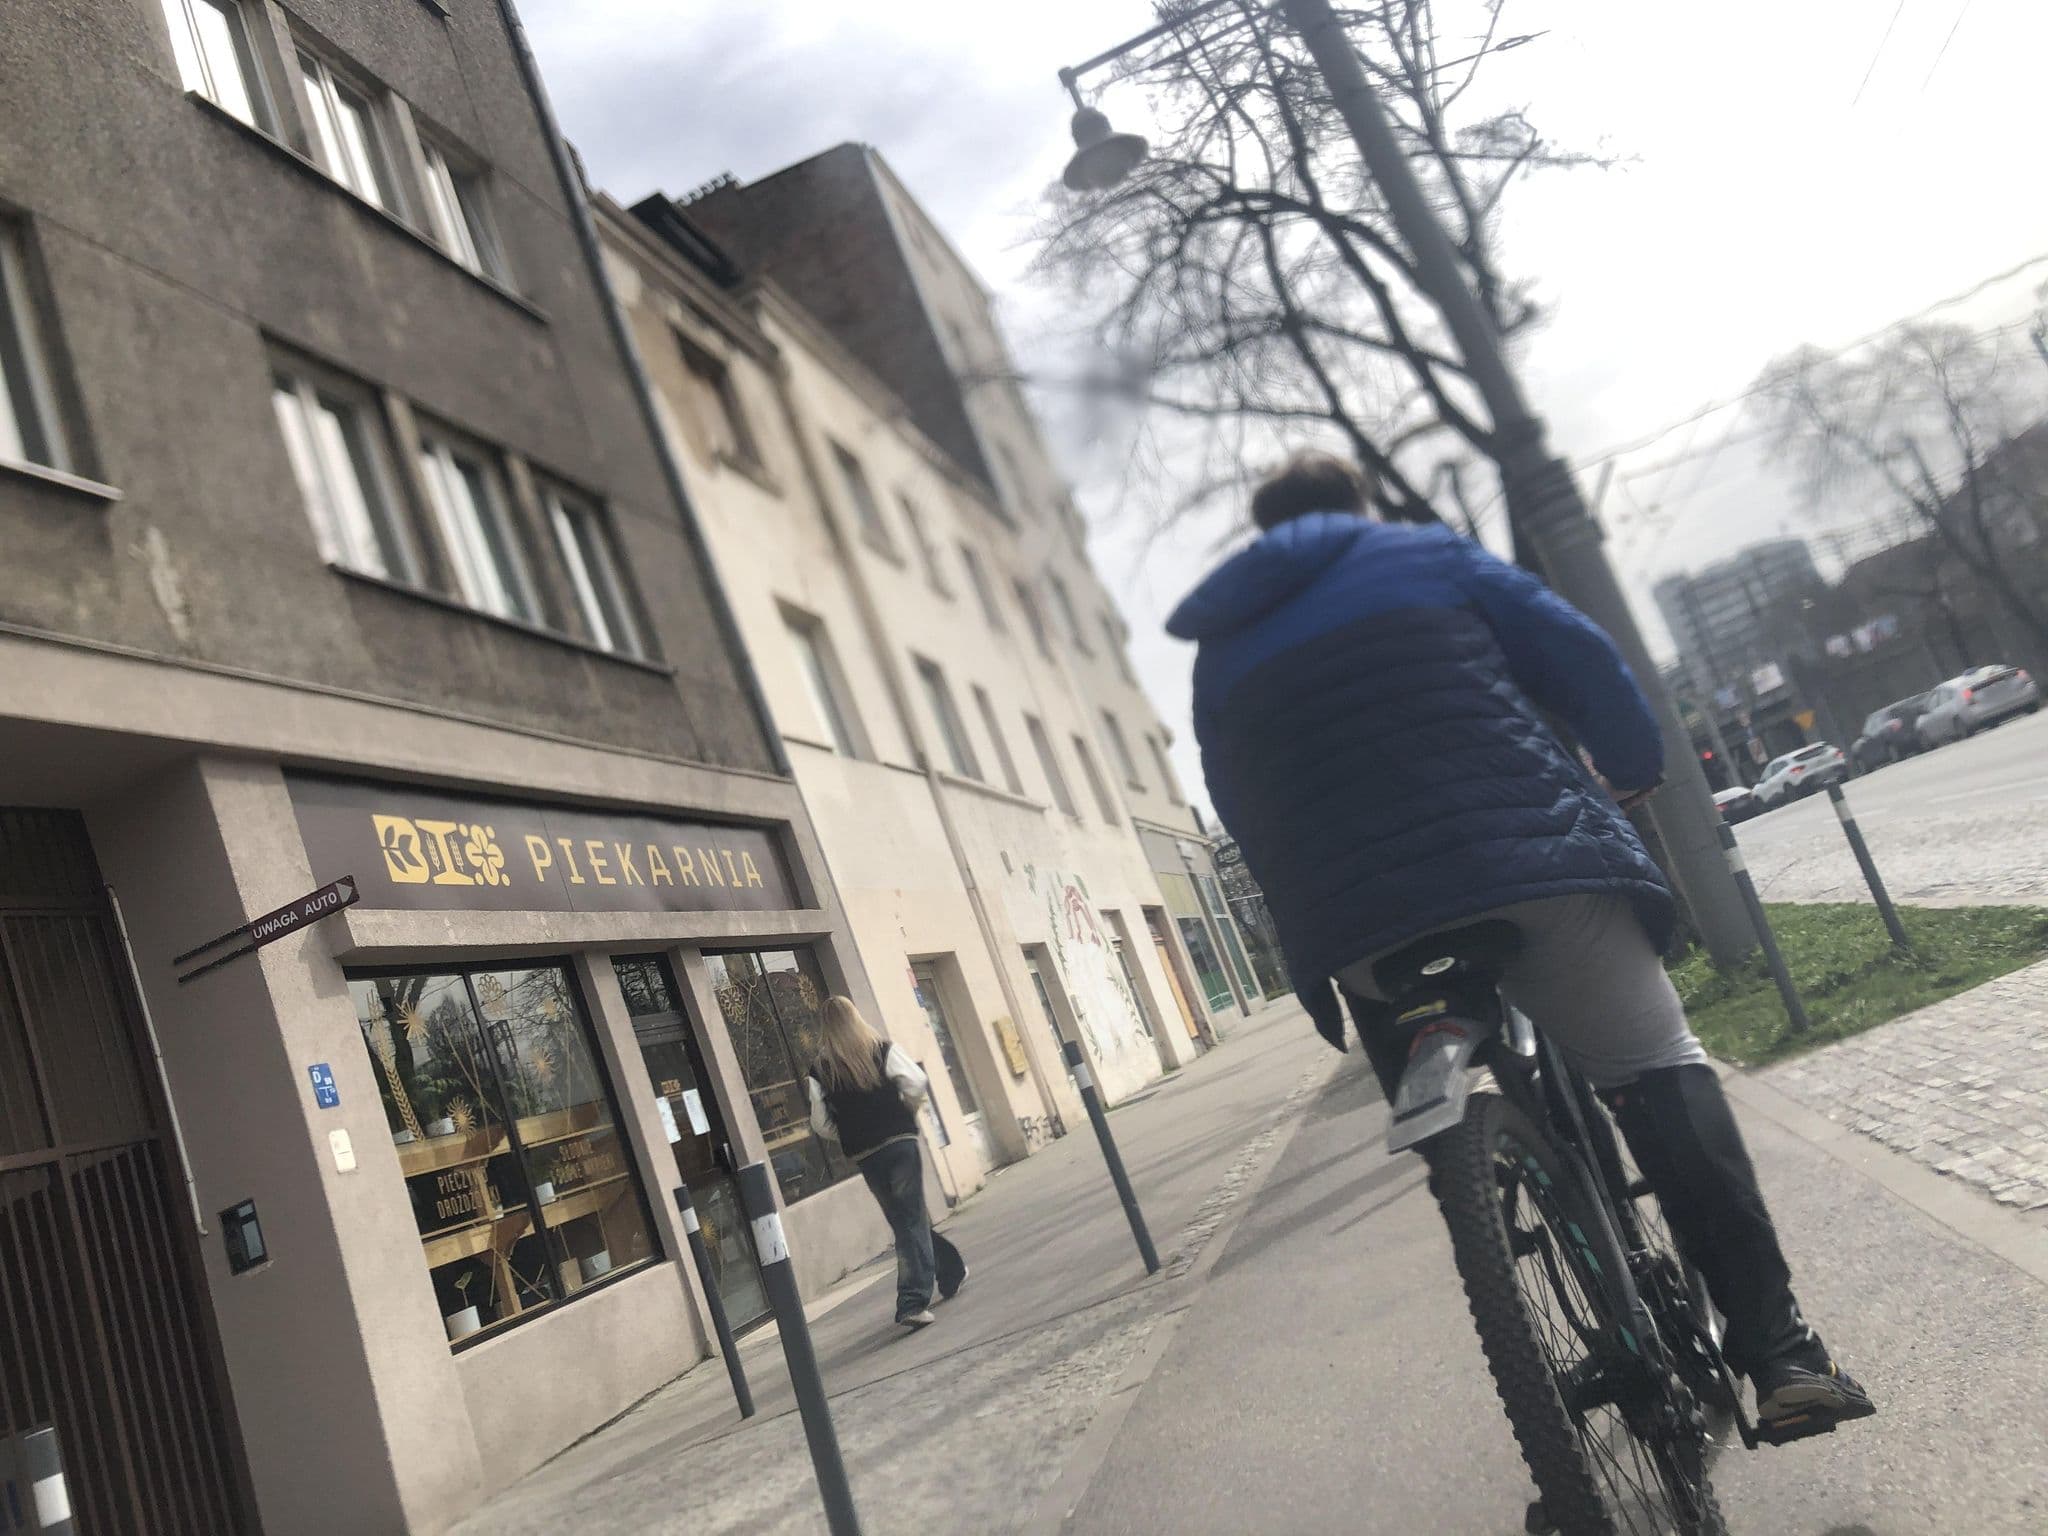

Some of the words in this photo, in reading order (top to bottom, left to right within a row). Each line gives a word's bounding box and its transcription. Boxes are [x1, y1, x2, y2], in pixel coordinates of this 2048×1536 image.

[524, 834, 764, 889] PIEKARNIA
[252, 911, 299, 940] UWAGA
[304, 892, 338, 917] AUTO
